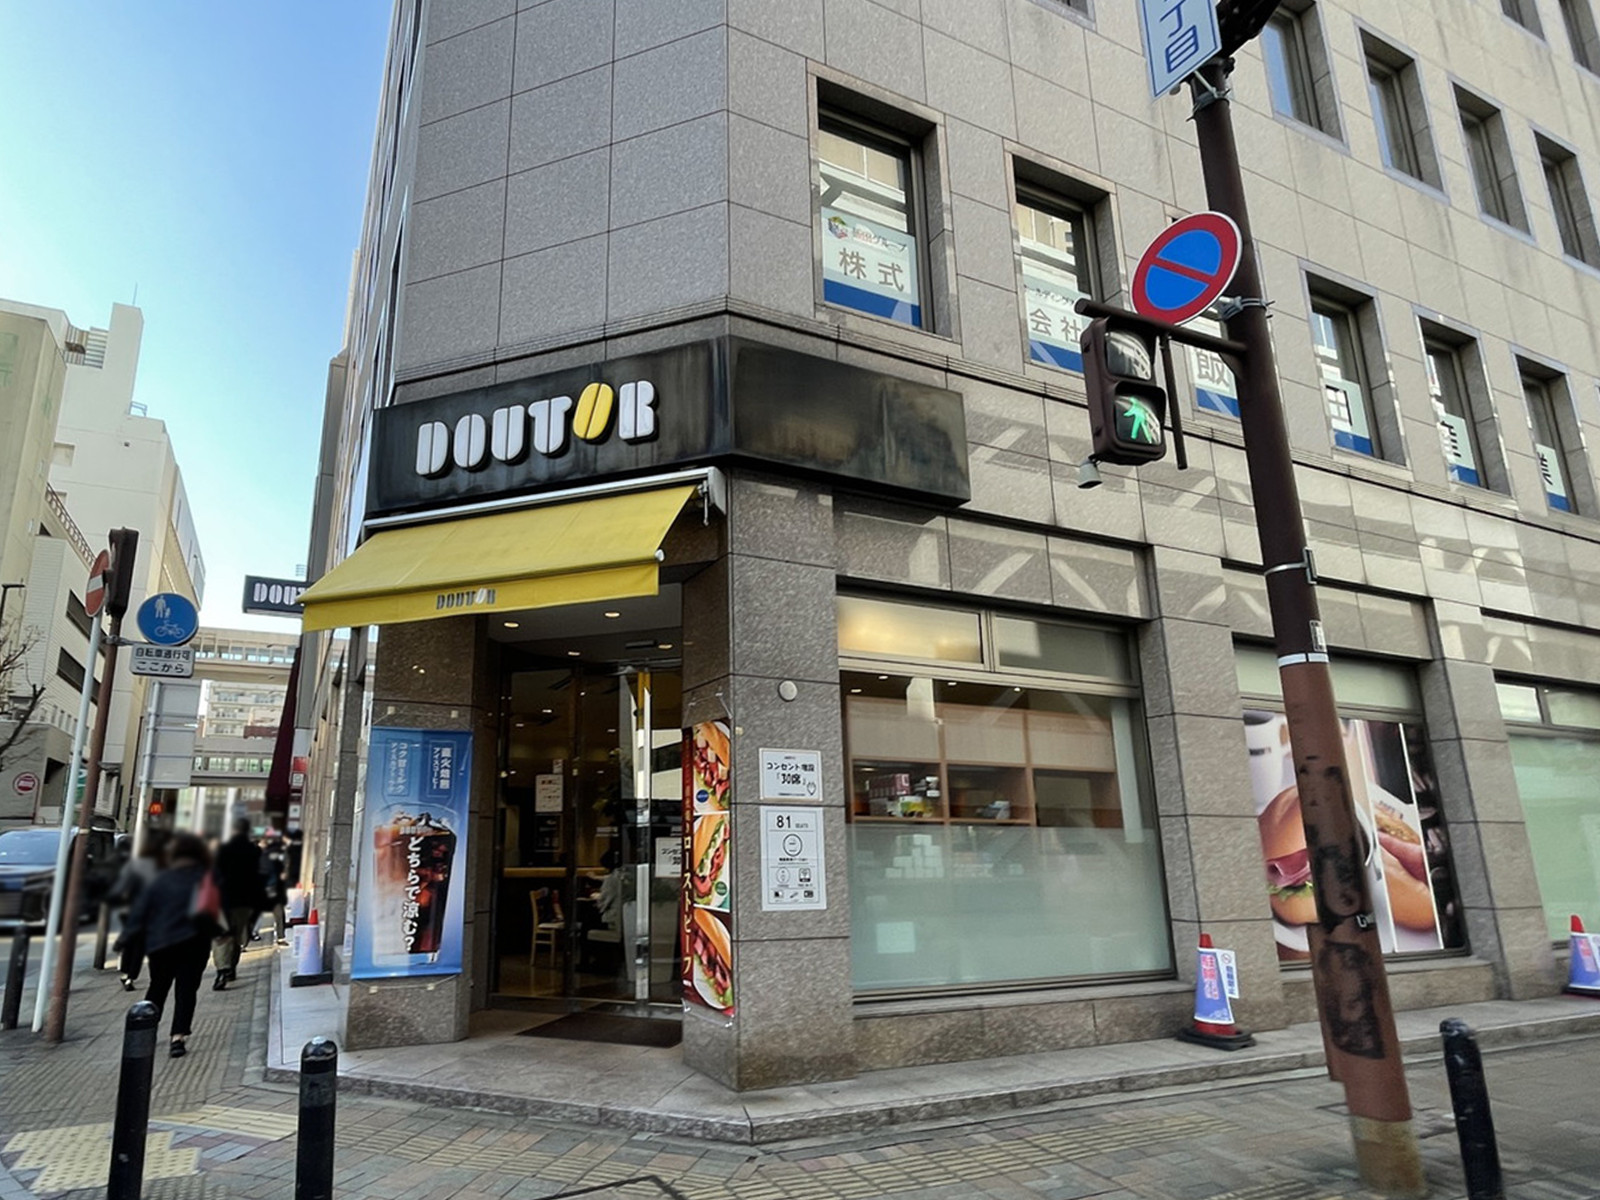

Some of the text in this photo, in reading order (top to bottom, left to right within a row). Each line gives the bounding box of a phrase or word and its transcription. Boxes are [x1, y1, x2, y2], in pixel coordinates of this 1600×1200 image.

[1159, 0, 1199, 74] 丁目
[839, 247, 905, 292] 株式
[1029, 308, 1082, 344] 会社
[415, 379, 658, 478] DOUTOR
[436, 588, 496, 610] DOUTOR
[136, 661, 185, 674] ここから
[776, 814, 791, 829] 81
